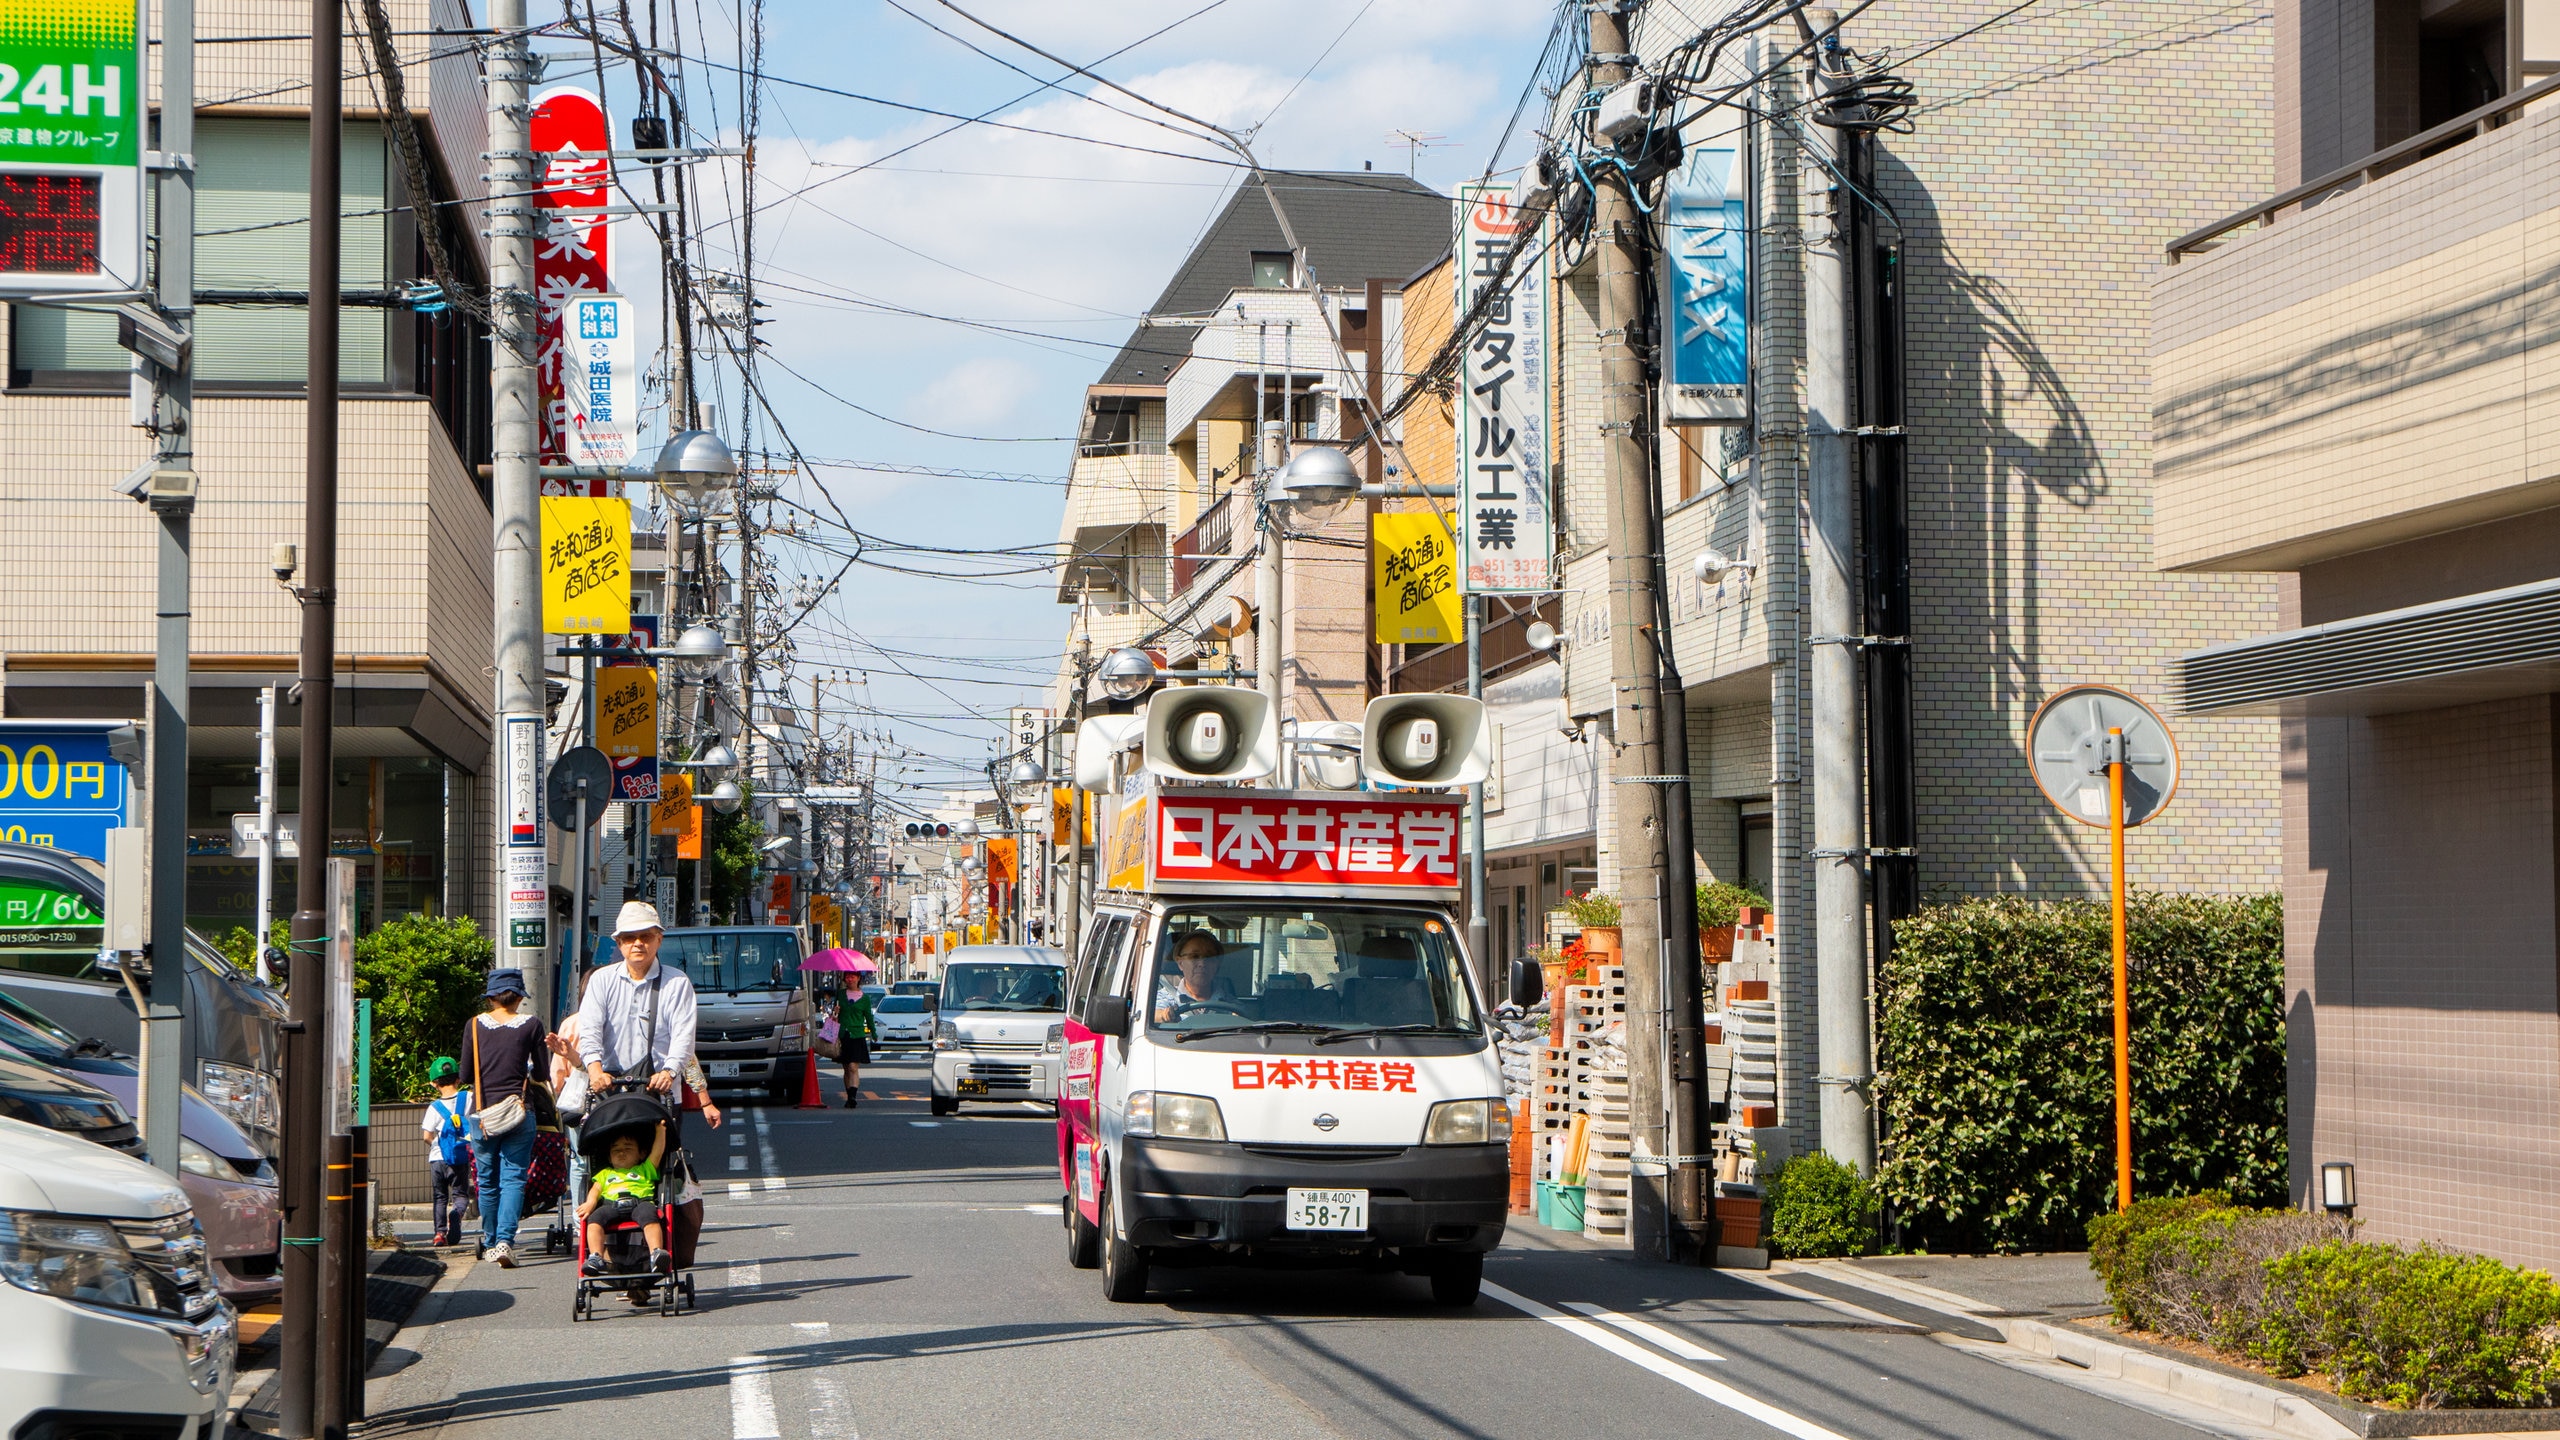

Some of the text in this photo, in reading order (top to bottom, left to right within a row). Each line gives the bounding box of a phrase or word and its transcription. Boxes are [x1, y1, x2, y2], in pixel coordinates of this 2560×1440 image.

[1681, 199, 1728, 347] INAX
[589, 361, 612, 422] 城田医院
[549, 519, 613, 574] 光和通り
[1385, 534, 1444, 587] 光和通り
[564, 551, 619, 602] 商店会
[1484, 559, 1548, 572] 951-3372
[1400, 564, 1451, 615] 商店会
[563, 616, 604, 629] 南長崎
[603, 681, 645, 717] 光和通り
[613, 703, 650, 736] 商店会
[515, 724, 531, 803] 野村の仲介
[622, 773, 653, 792] Ban
[628, 783, 658, 799] Ban
[1160, 805, 1456, 874] 日本共産党
[1231, 1059, 1417, 1093] 日本共産党
[1307, 1192, 1351, 1204] 練馬 400
[1294, 1206, 1360, 1227] さ 58-71
